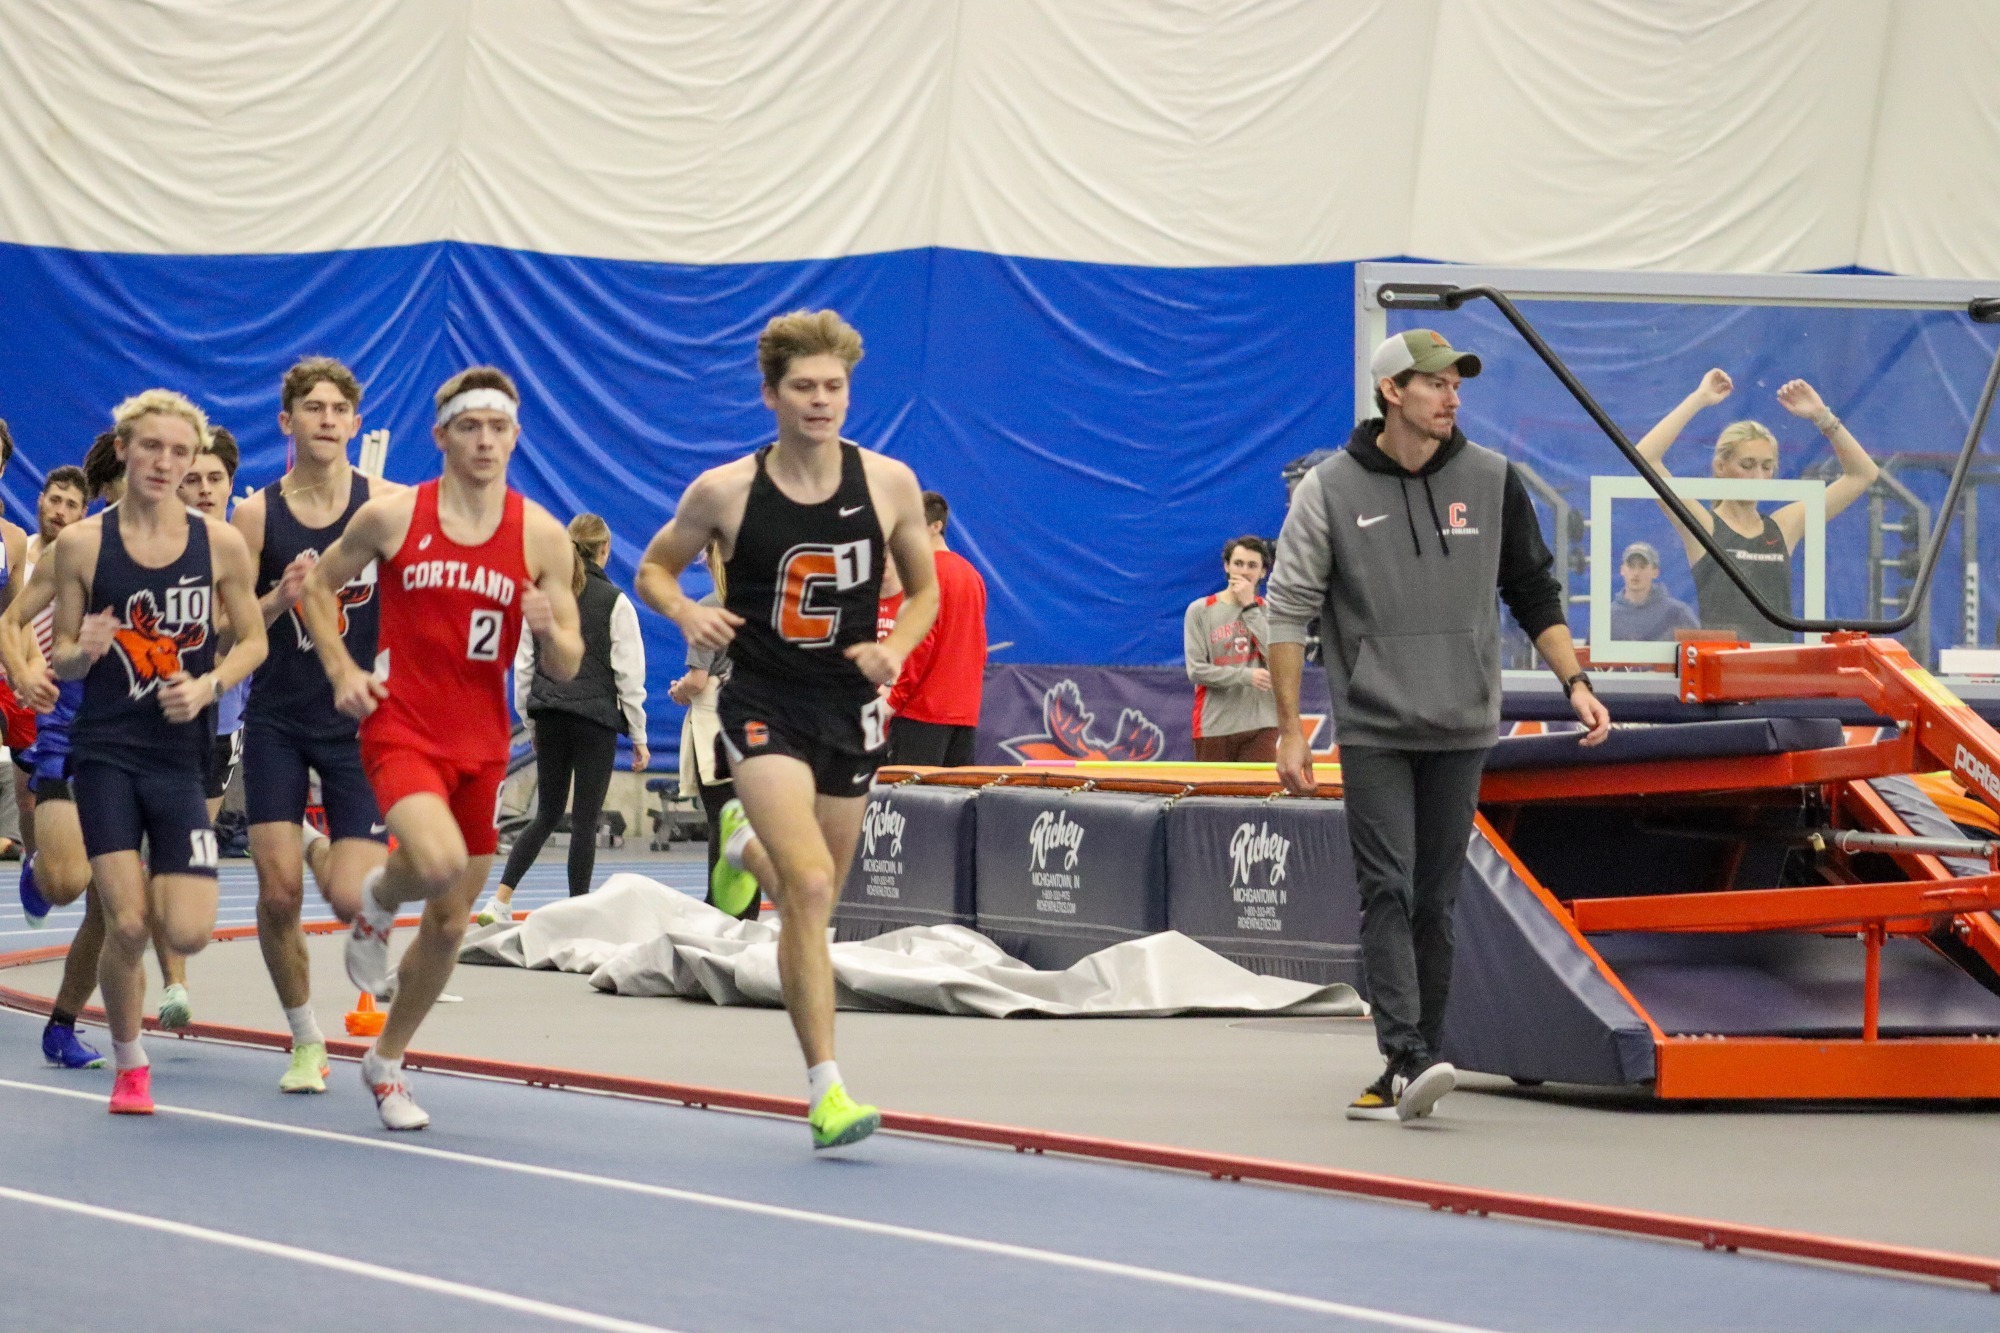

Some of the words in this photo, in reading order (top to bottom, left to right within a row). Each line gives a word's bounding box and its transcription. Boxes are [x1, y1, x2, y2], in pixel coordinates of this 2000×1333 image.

[1449, 502, 1467, 527] C
[403, 560, 515, 606] CORTLAND
[841, 545, 859, 583] 1
[170, 589, 204, 620] 10
[771, 543, 841, 649] C
[473, 615, 497, 656] 2
[861, 800, 906, 858] Richey
[1029, 809, 1085, 872] Richey
[1229, 821, 1291, 888] Richey
[1280, 890, 1287, 904] IN
